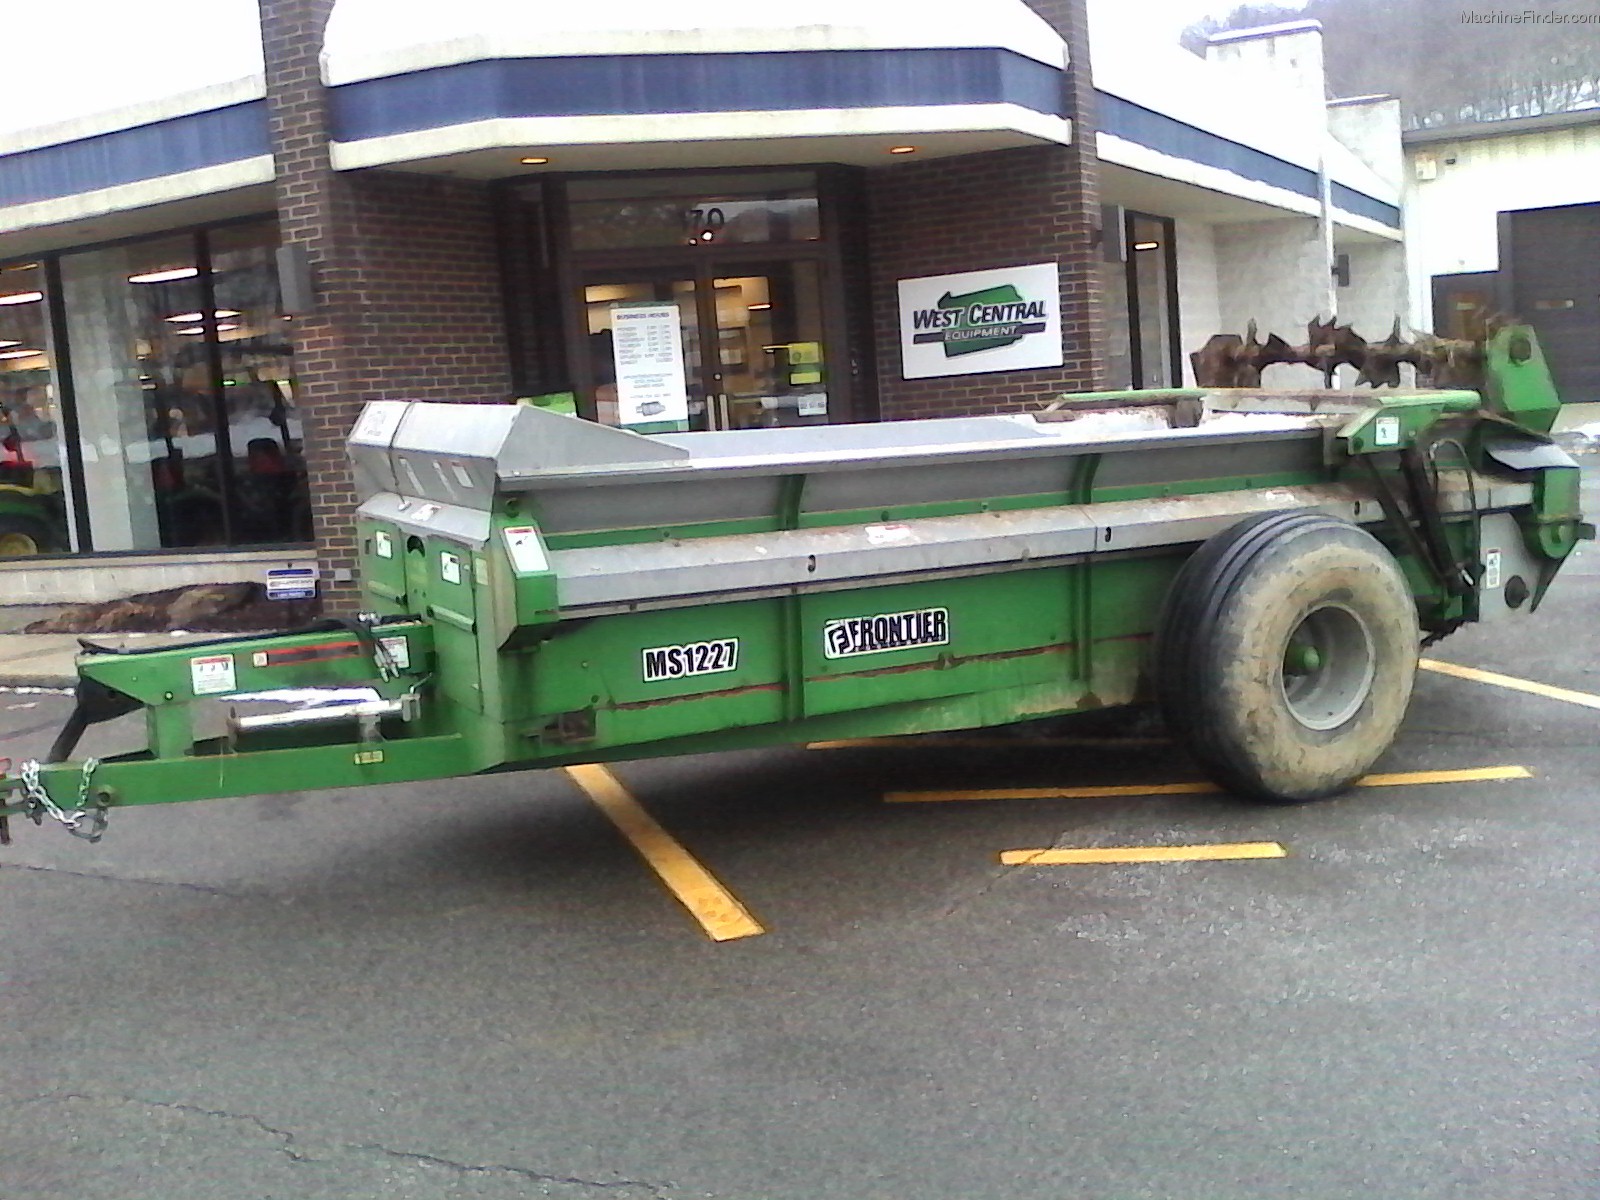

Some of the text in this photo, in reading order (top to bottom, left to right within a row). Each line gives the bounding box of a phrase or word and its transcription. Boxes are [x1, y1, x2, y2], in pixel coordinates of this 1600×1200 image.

[913, 300, 1047, 330] WEST CENTRAL
[944, 325, 1017, 341] EQUIPMENT
[850, 610, 948, 650] FRONTIER
[646, 642, 735, 678] MS1227
